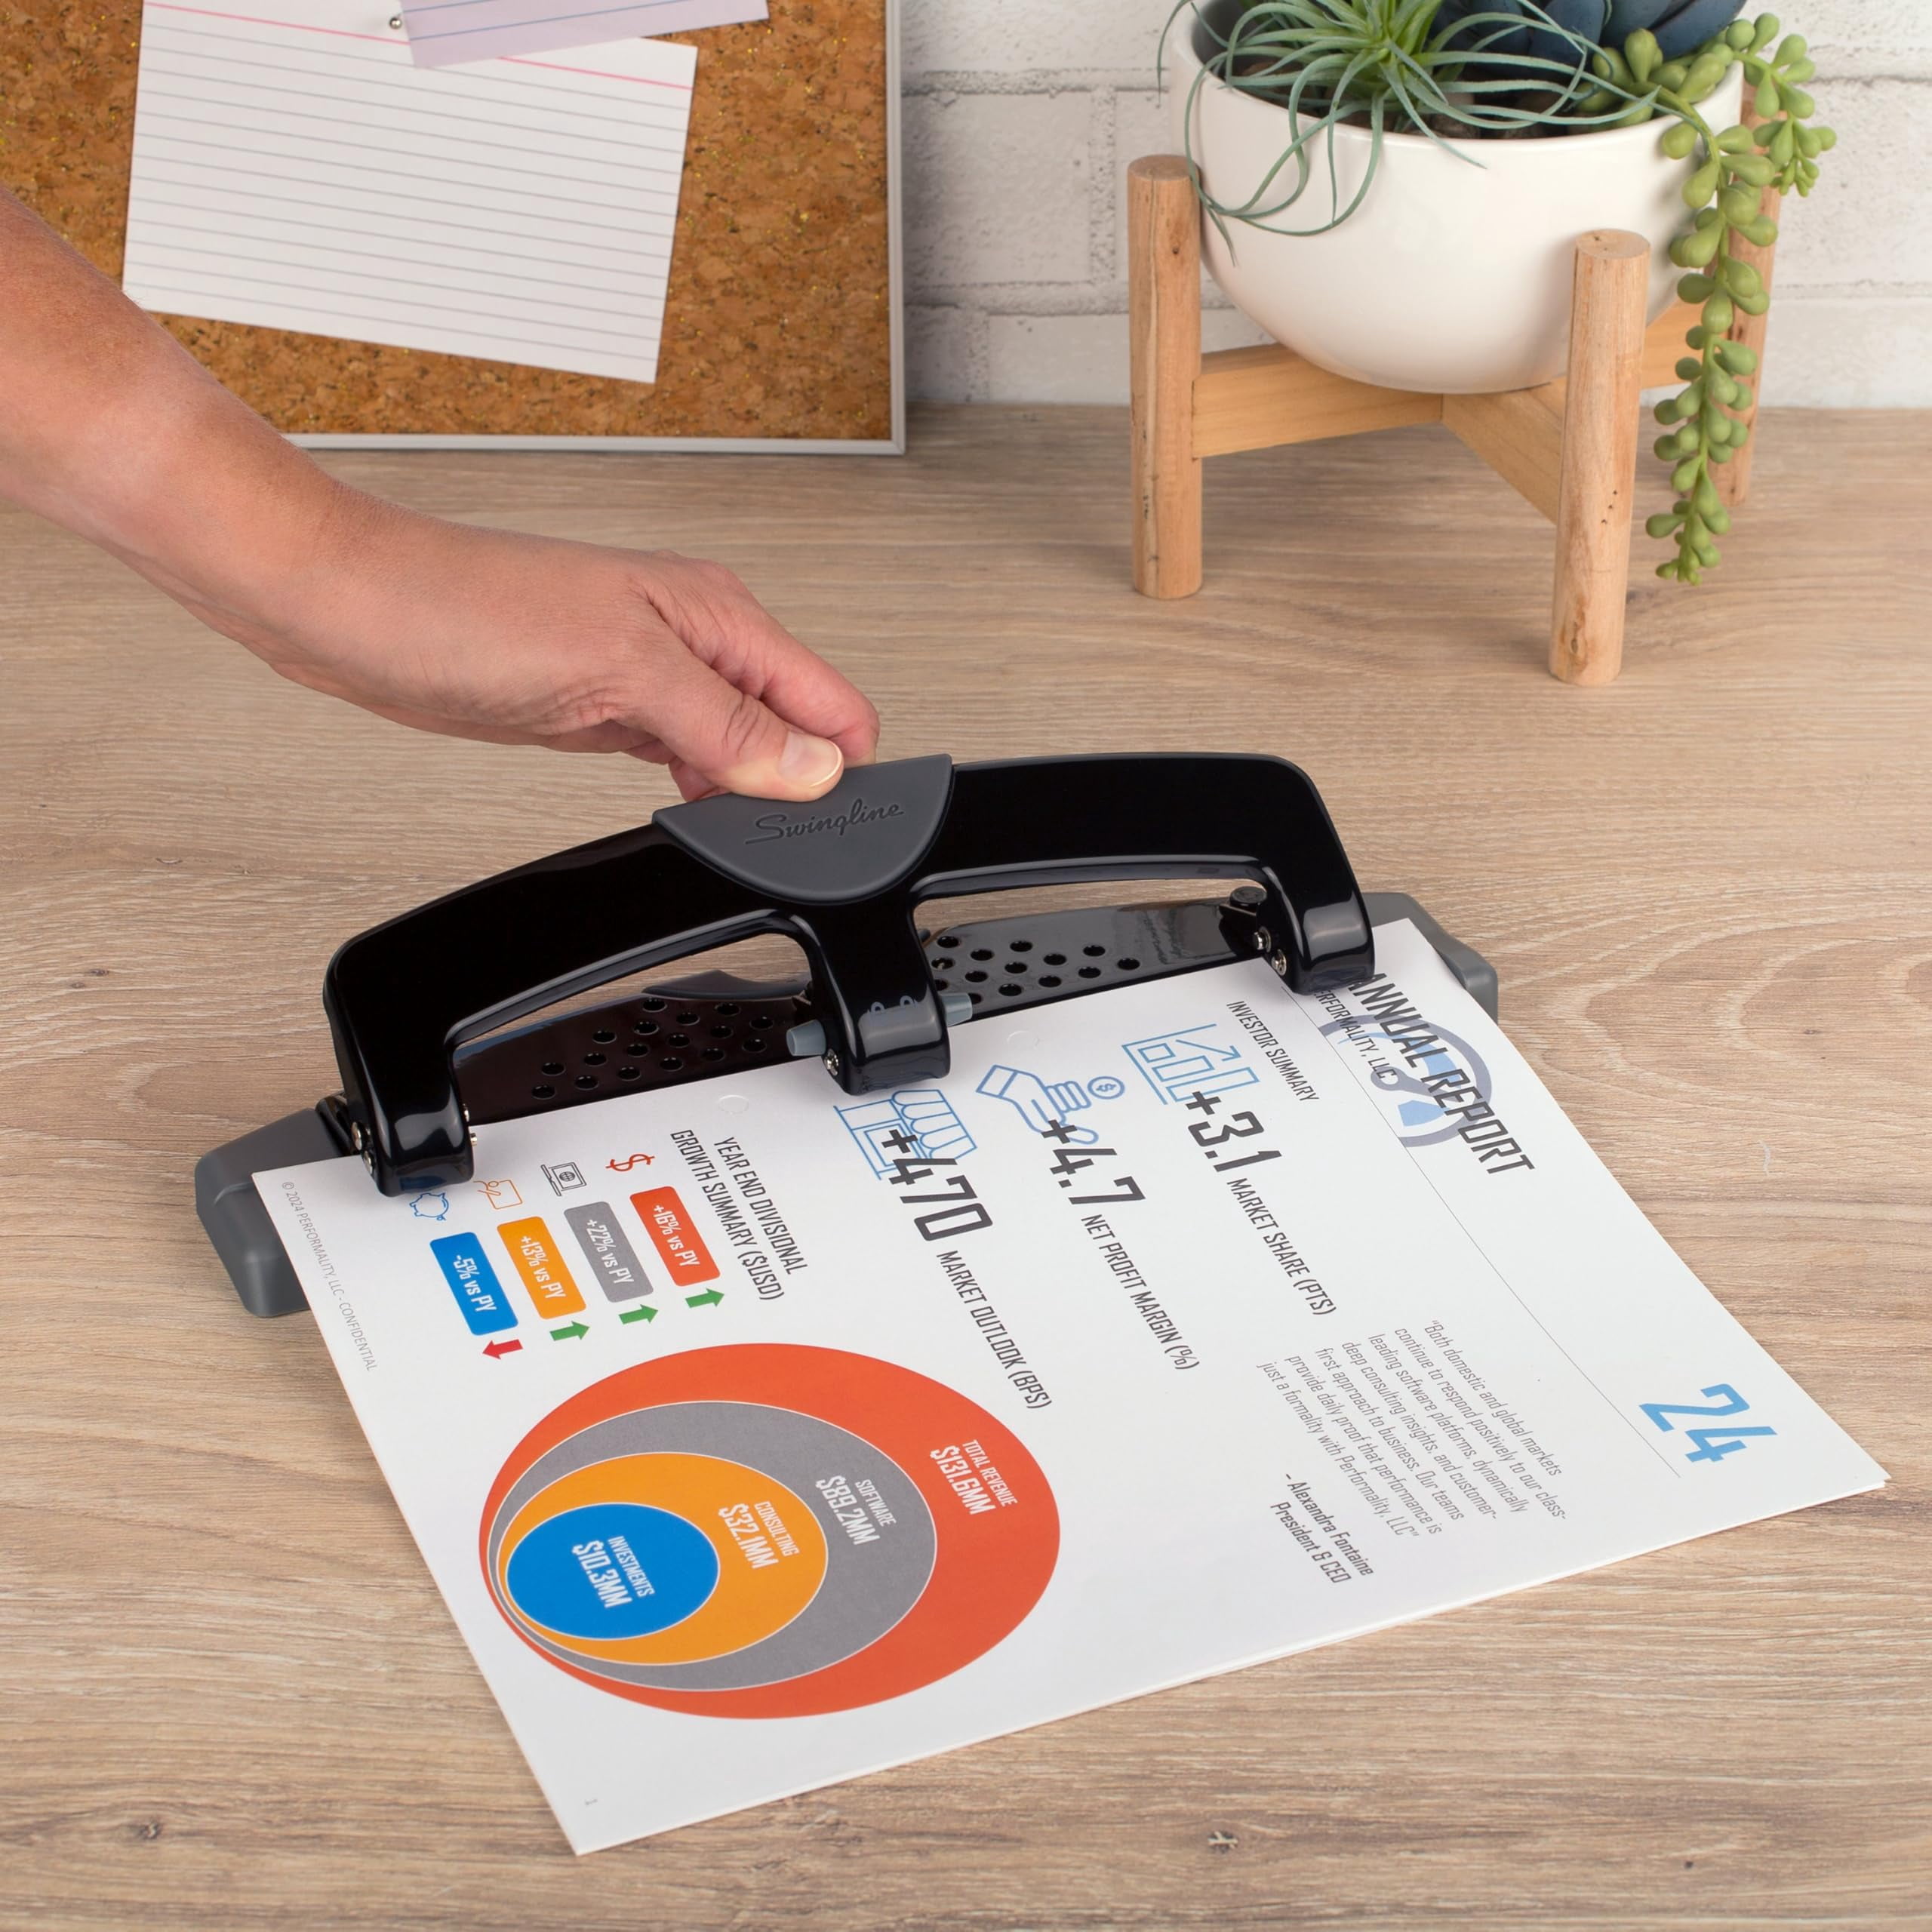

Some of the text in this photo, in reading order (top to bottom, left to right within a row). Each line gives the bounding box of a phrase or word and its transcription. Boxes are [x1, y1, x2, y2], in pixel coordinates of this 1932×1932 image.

[745, 798, 904, 844] Swingline
[1226, 1001, 1319, 1100] INVESTOR SUMMARY
[1368, 1057, 1397, 1079] LLC
[1041, 1119, 1146, 1204] +4.7
[1185, 1091, 1282, 1172] +3.1
[1420, 1069, 1534, 1174] REPORT
[670, 1129, 785, 1300] GROWTH SUMMARY ($USD)
[714, 1137, 808, 1275] YEAR END DIVISIONAL
[881, 1129, 993, 1241] +470
[521, 1235, 566, 1298] +13% vs PY
[586, 1219, 635, 1284] +22% vs PY
[653, 1204, 700, 1266] +16% vs PY
[1226, 1178, 1337, 1315] MARKET SHARE (PTS)
[286, 1192, 305, 1211] 2024
[297, 1213, 336, 1278] PERFORMALITY,
[328, 1280, 344, 1296] LLC
[339, 1303, 377, 1371] CONFIDENTIAL
[454, 1255, 497, 1312] -5% vs PY
[1081, 1214, 1200, 1370] NET PROFIT MARGIN (%)
[937, 1250, 1052, 1409] MARKET OUTLOOK (BPS)
[1443, 1349, 1485, 1391] domestic
[1479, 1392, 1508, 1409] and
[1256, 1361, 1286, 1382] just
[1283, 1390, 1324, 1433] formality
[1318, 1435, 1346, 1456] with
[1334, 1455, 1391, 1518] Performality,
[1284, 1355, 1442, 1534] provide daily proof that performance is
[1315, 1348, 1464, 1520] first approach to business. Our teams
[1342, 1342, 1497, 1519] deep consulting insights, and customer-
[1368, 1334, 1529, 1512] leading software platforms, dynamically
[1395, 1328, 1566, 1519] continue to respond positively to our class-
[1491, 1410, 1534, 1437] global
[1520, 1438, 1562, 1476] markets
[1638, 1383, 1778, 1463] 24
[815, 1474, 880, 1546] $89.2MM
[854, 1478, 897, 1527] SOFTWARE
[930, 1444, 996, 1515] $131.6MM
[962, 1439, 1018, 1507] TOTAL REVENUE
[608, 1535, 655, 1598] INVESTMENTS
[718, 1503, 779, 1569] $32.1MM
[754, 1500, 800, 1557] CONSULTING
[1270, 1501, 1352, 1583] President & CEO
[1287, 1481, 1337, 1533] Alexandra
[1330, 1531, 1374, 1576] Fontaine
[571, 1540, 632, 1608] $10.3MM
